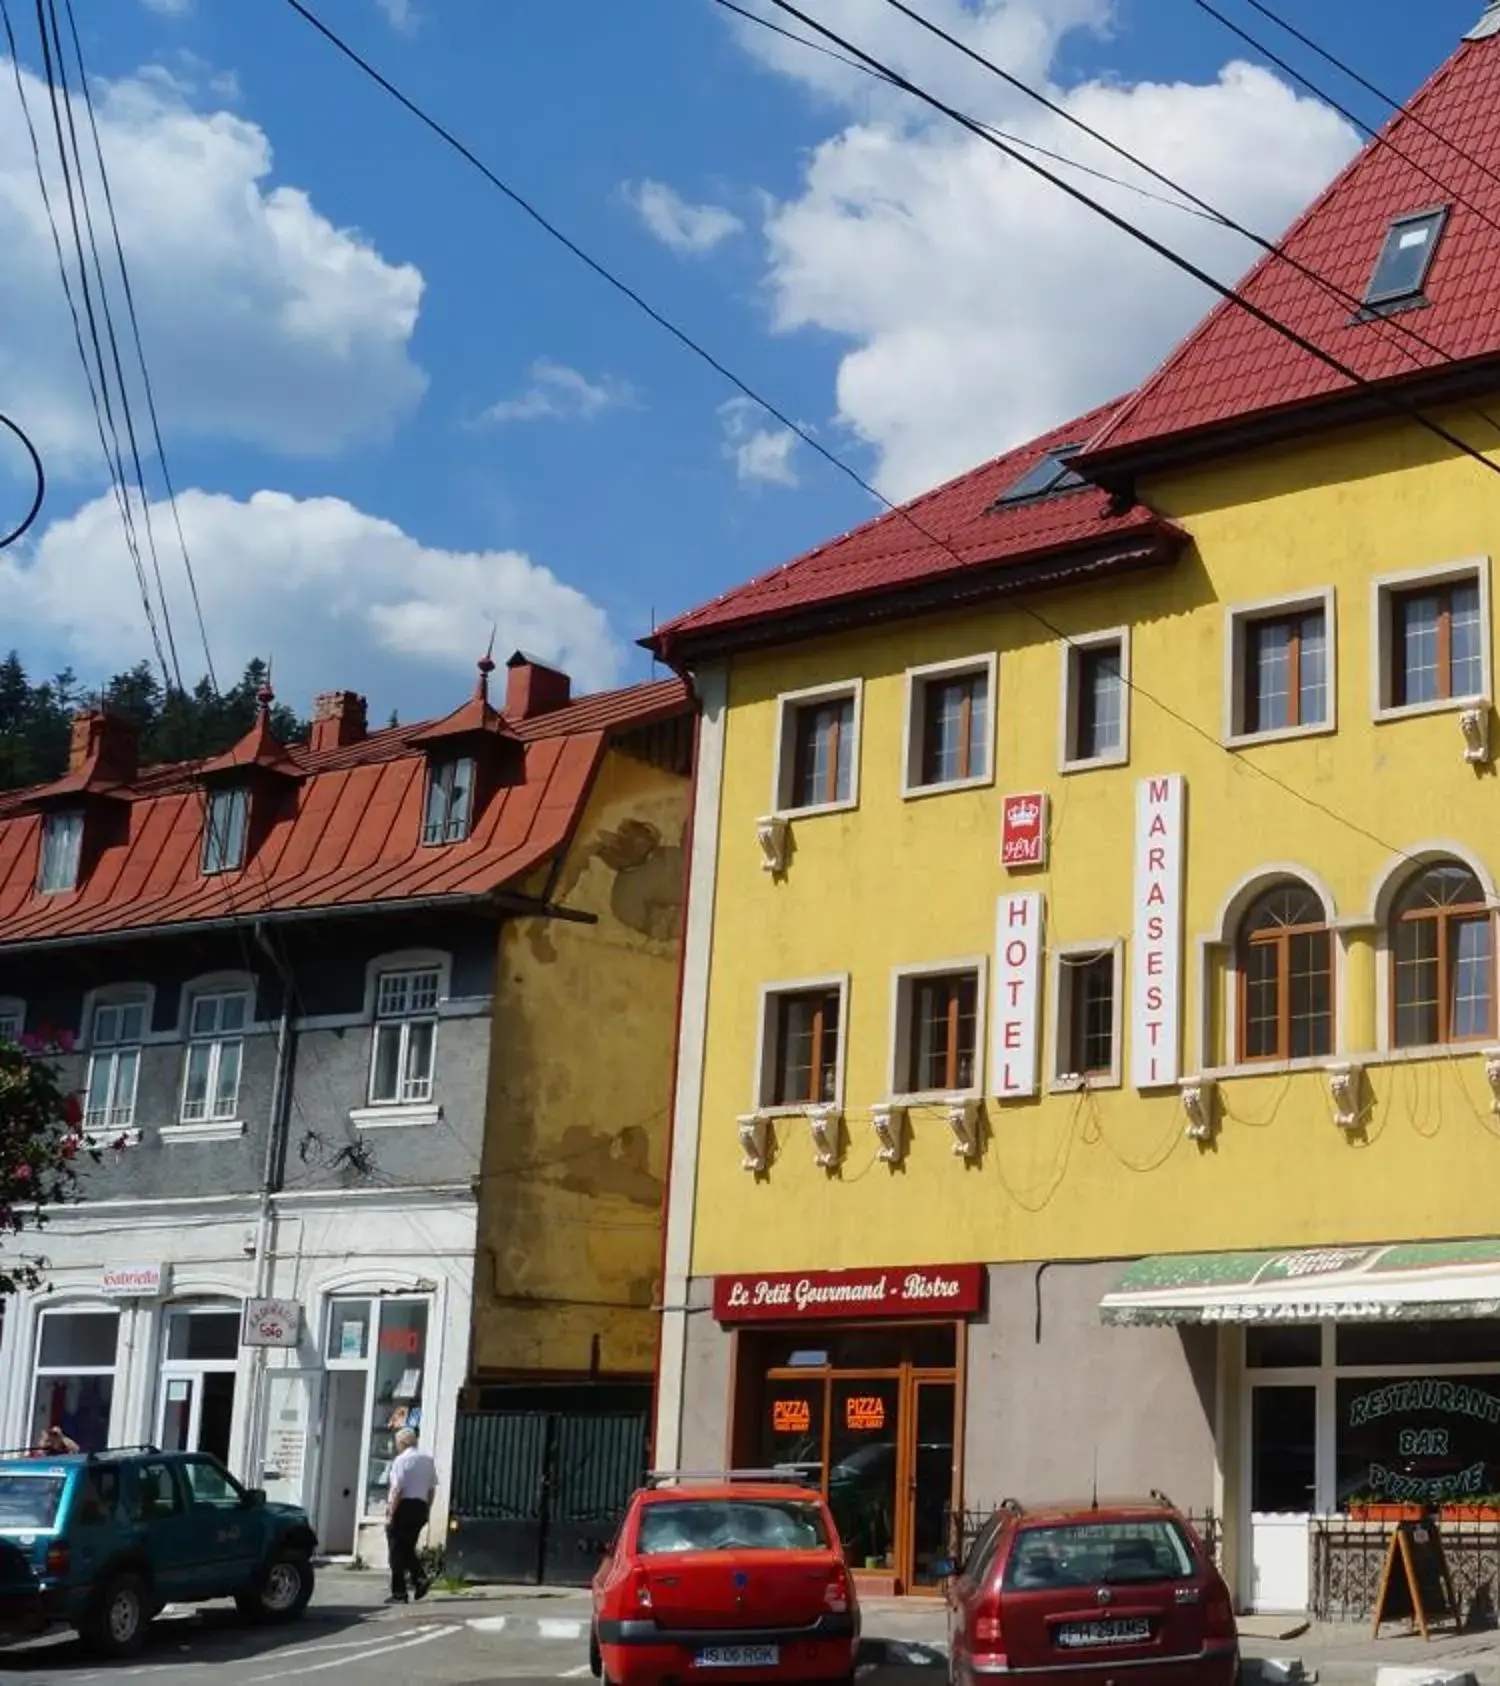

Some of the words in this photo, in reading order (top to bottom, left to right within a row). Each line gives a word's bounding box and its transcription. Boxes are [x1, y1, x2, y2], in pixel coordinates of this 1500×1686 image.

[1146, 779, 1169, 1081] MARASESTI
[1004, 900, 1027, 1091] HOTEL
[728, 1282, 749, 1307] Le
[753, 1280, 790, 1305] Petit
[795, 1275, 887, 1311] Gourmand
[902, 1273, 961, 1299] Bistro
[774, 1400, 809, 1418] PIZZA
[847, 1397, 884, 1416] PIZZA
[1400, 1428, 1449, 1456] BAR
